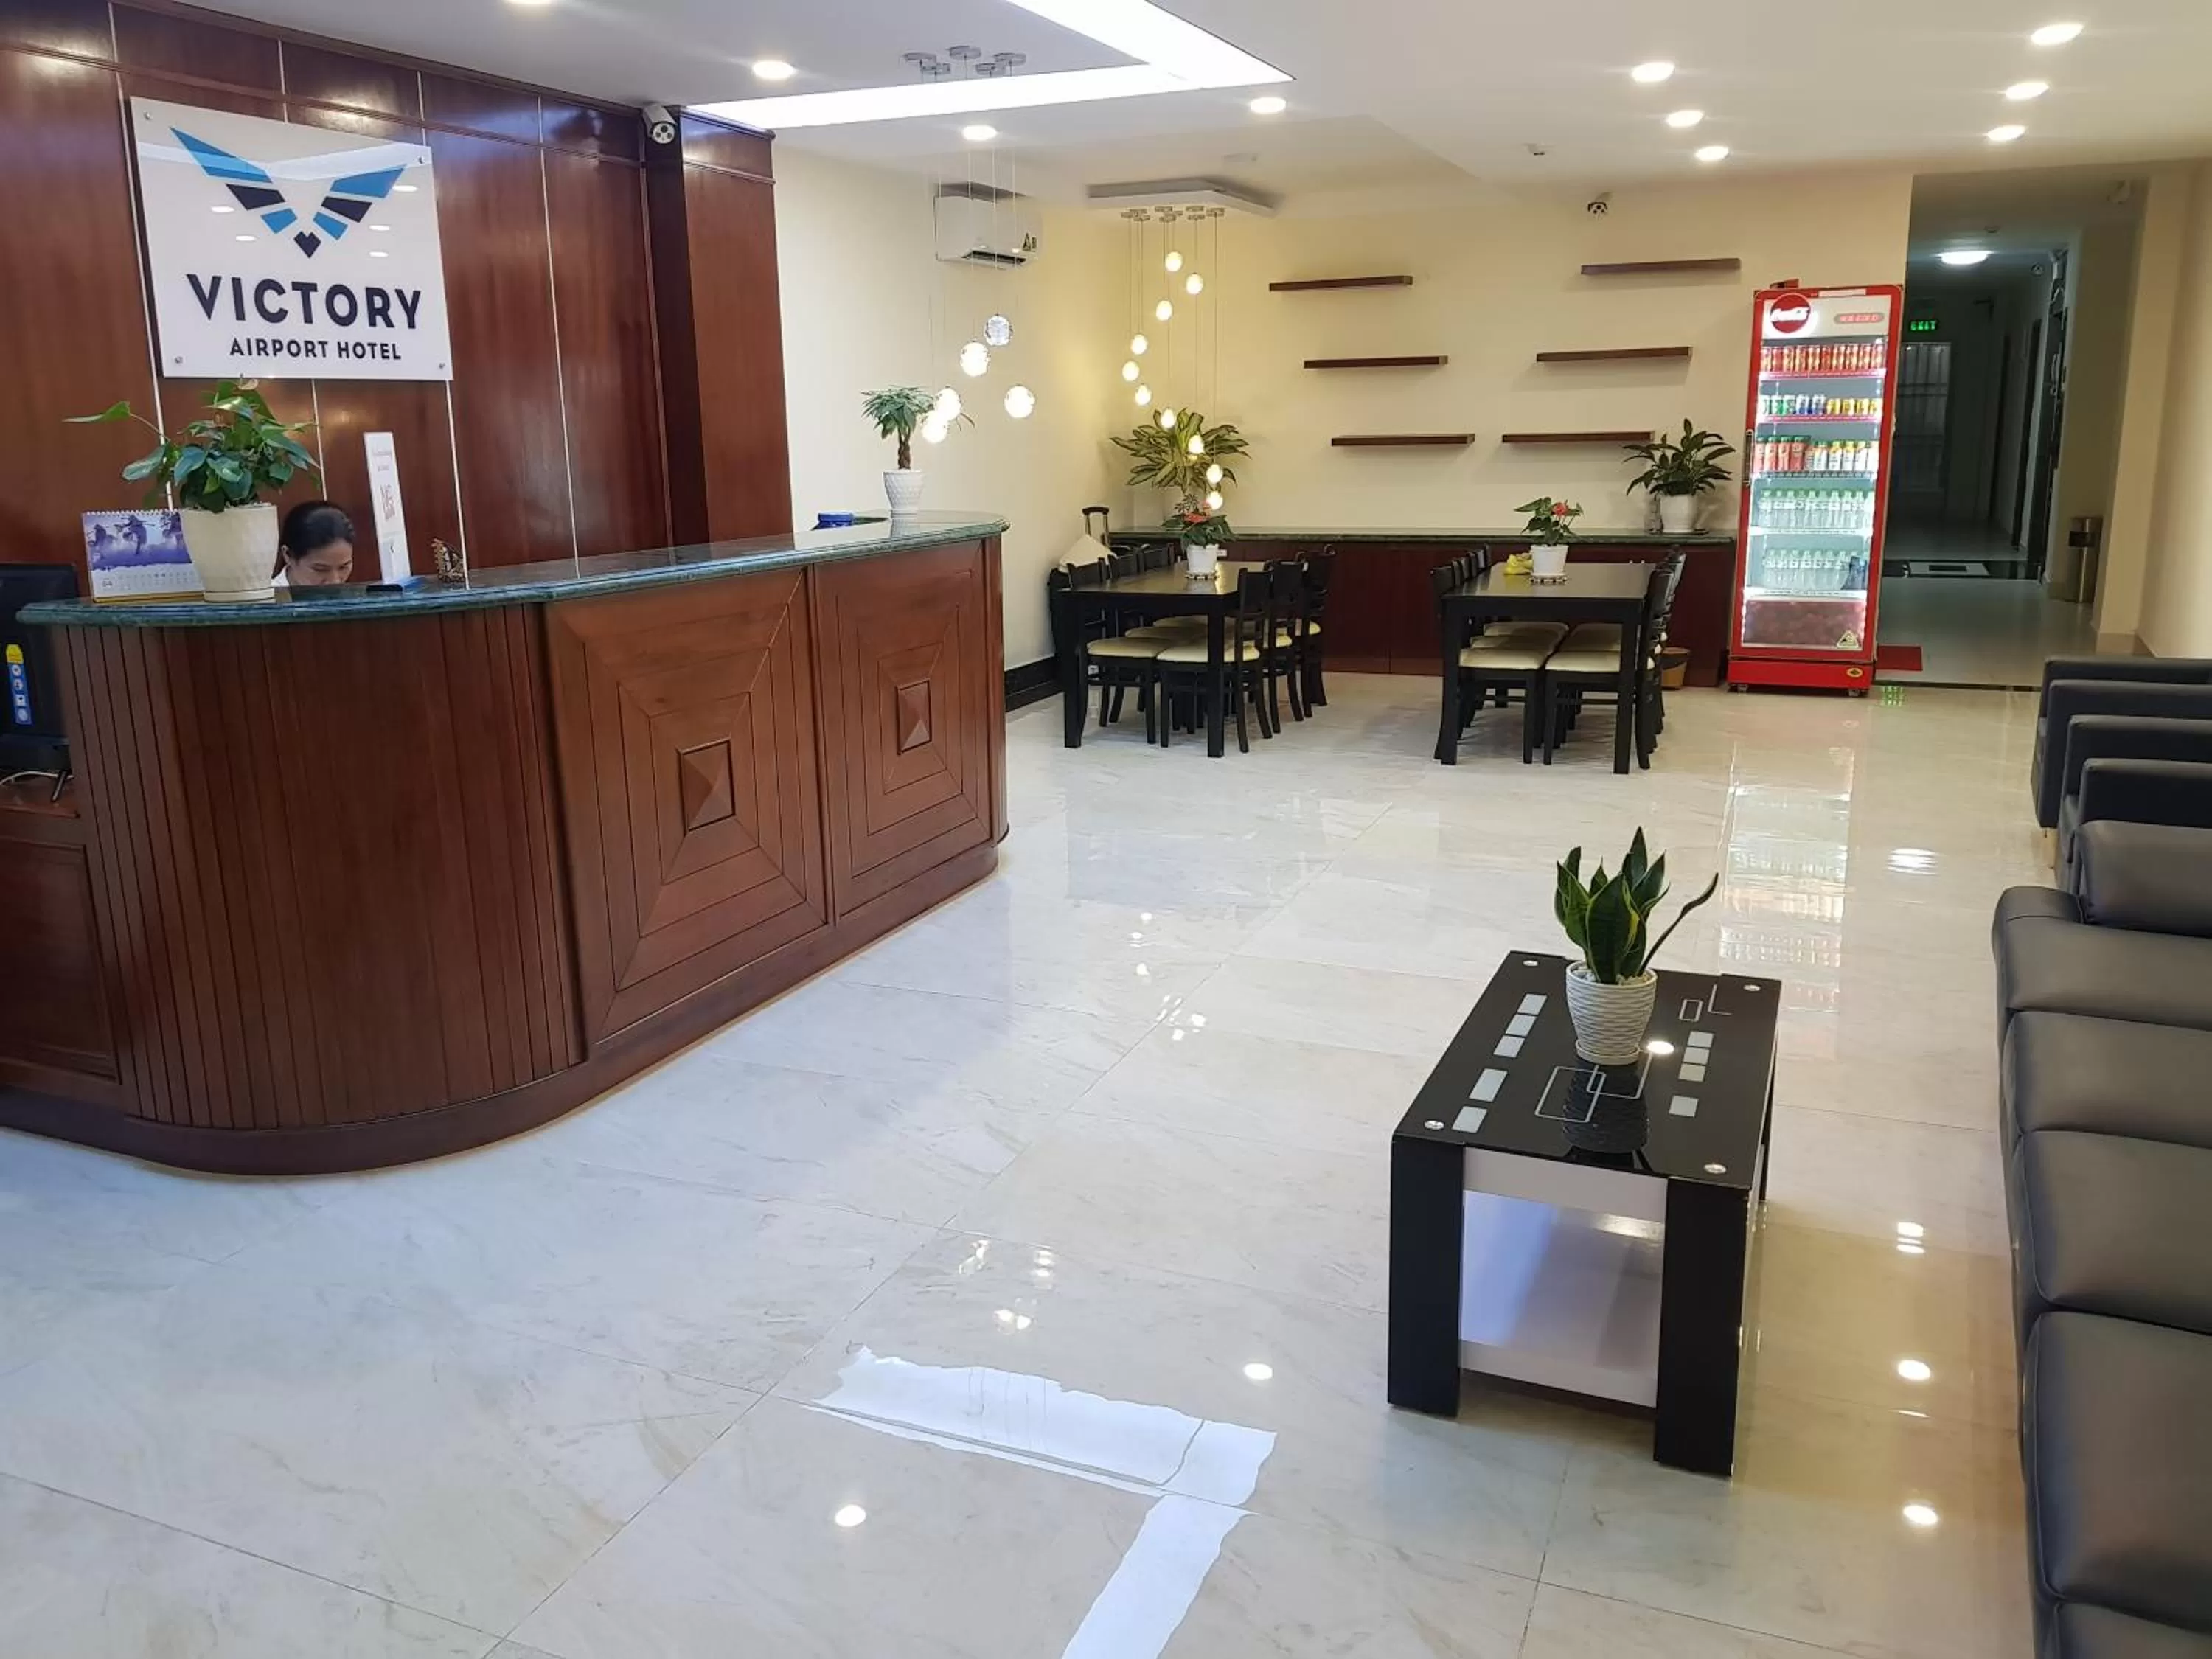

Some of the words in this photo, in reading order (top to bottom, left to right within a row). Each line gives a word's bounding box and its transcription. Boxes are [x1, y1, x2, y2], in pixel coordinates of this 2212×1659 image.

[187, 274, 421, 329] VICTORY
[1910, 320, 1936, 331] EXIT
[230, 338, 328, 358] AIRPORT
[337, 341, 401, 360] HOTEL
